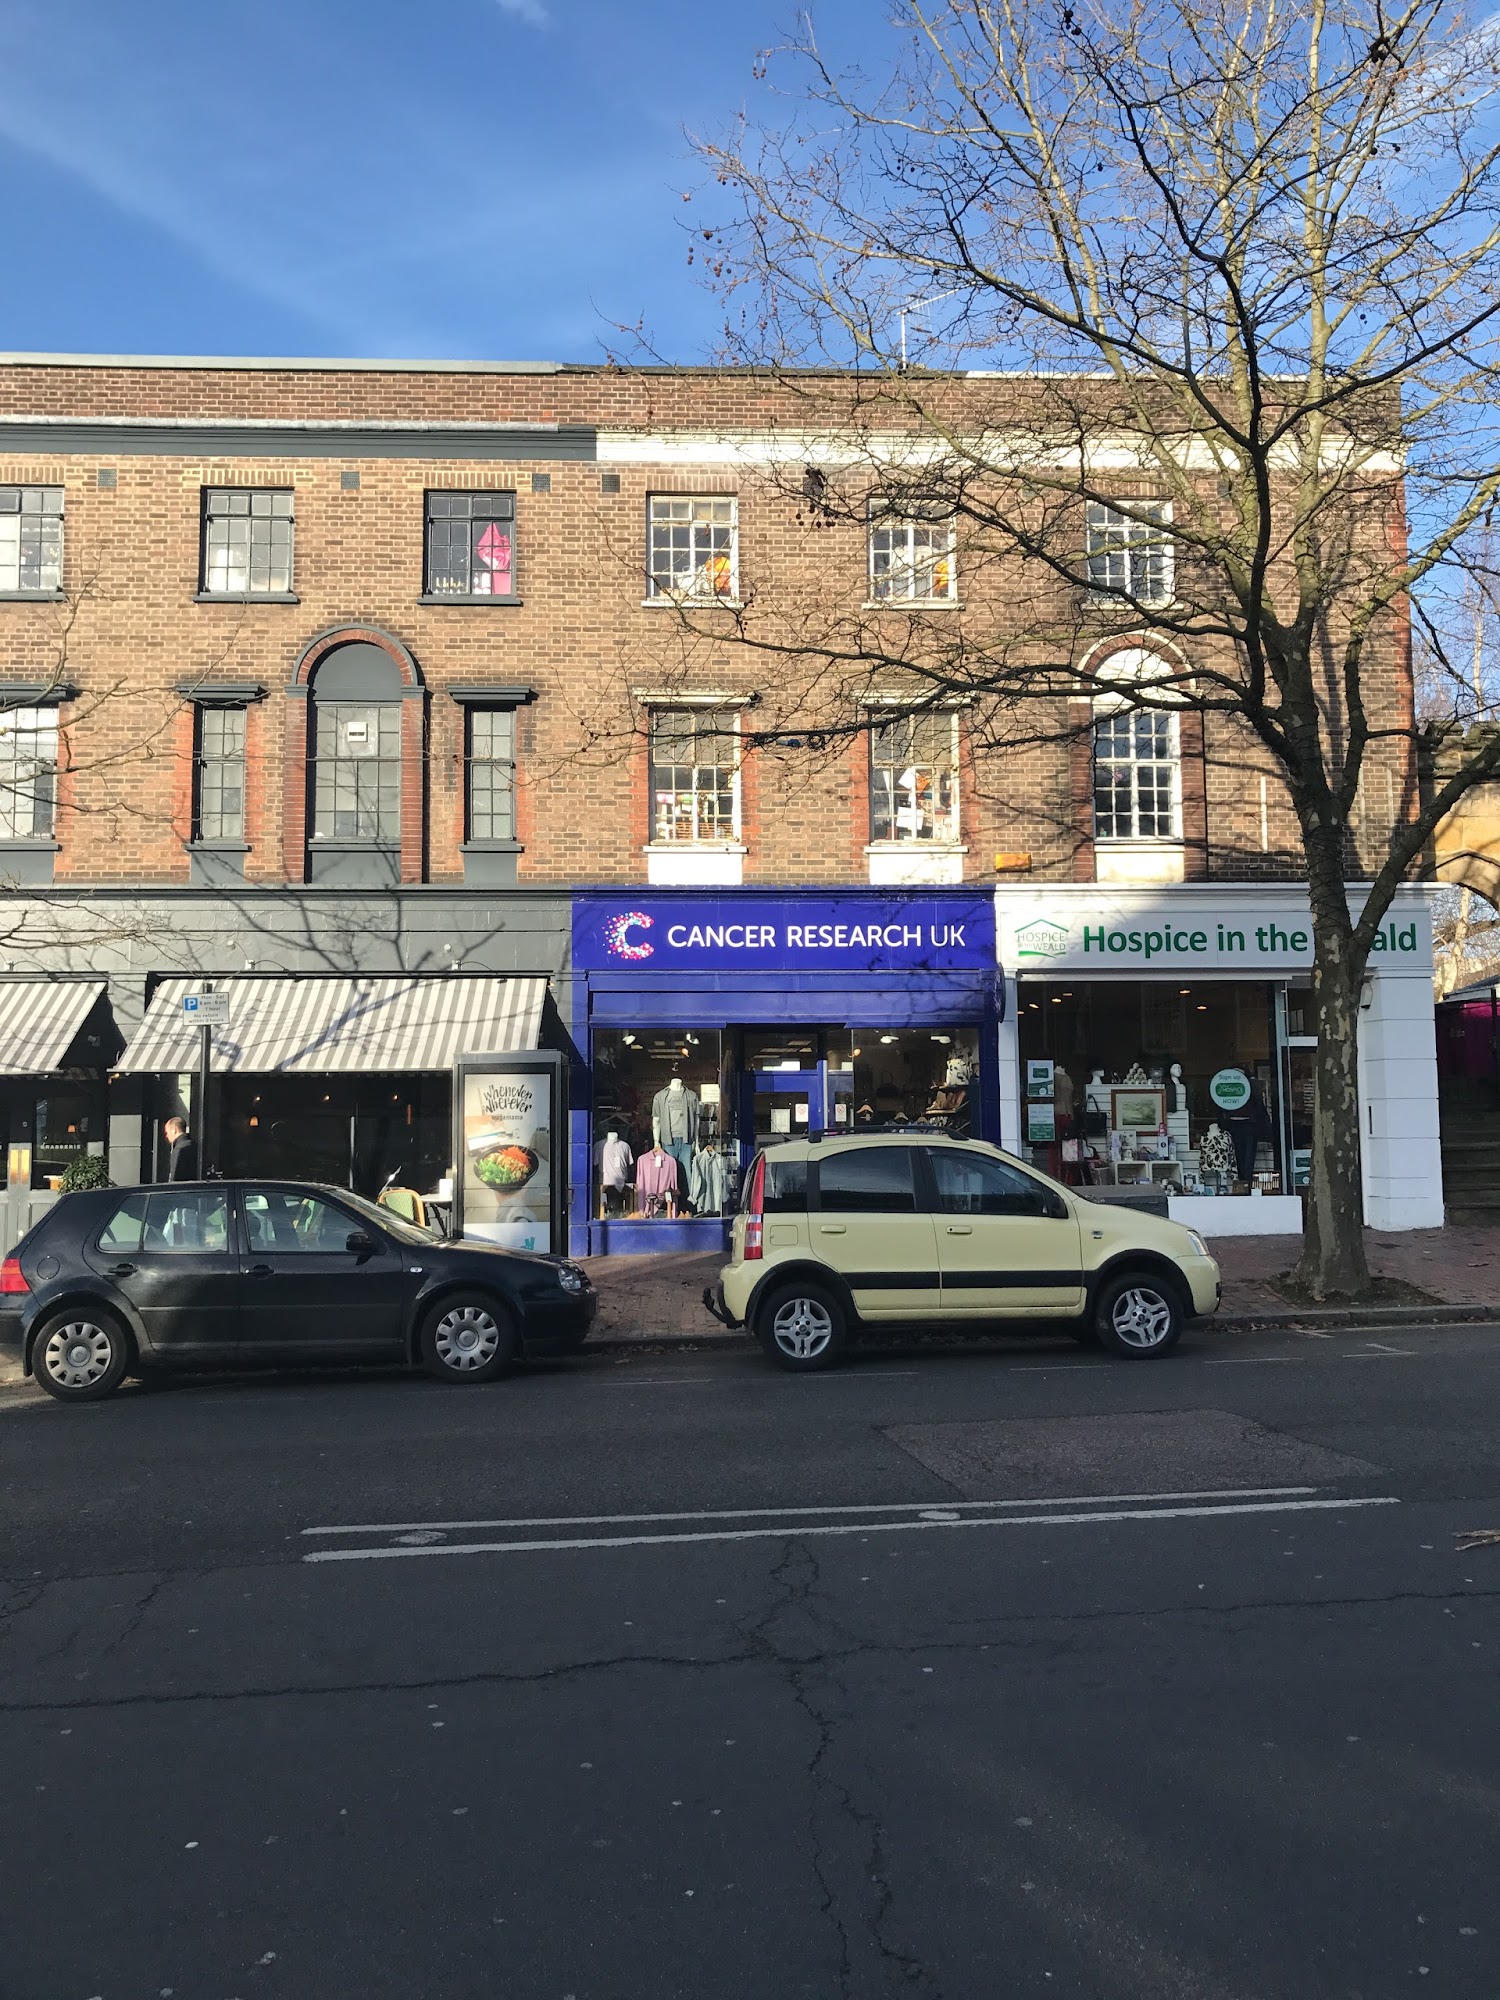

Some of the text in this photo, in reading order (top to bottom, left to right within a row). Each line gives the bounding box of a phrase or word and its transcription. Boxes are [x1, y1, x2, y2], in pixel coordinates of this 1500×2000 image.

[667, 924, 966, 948] CANCER RESEARCH UK
[1017, 932, 1065, 942] HOSPICE
[1083, 923, 1208, 959] Hospice
[1217, 923, 1246, 952] in
[1255, 923, 1308, 952] the
[1033, 942, 1066, 951] WEALD
